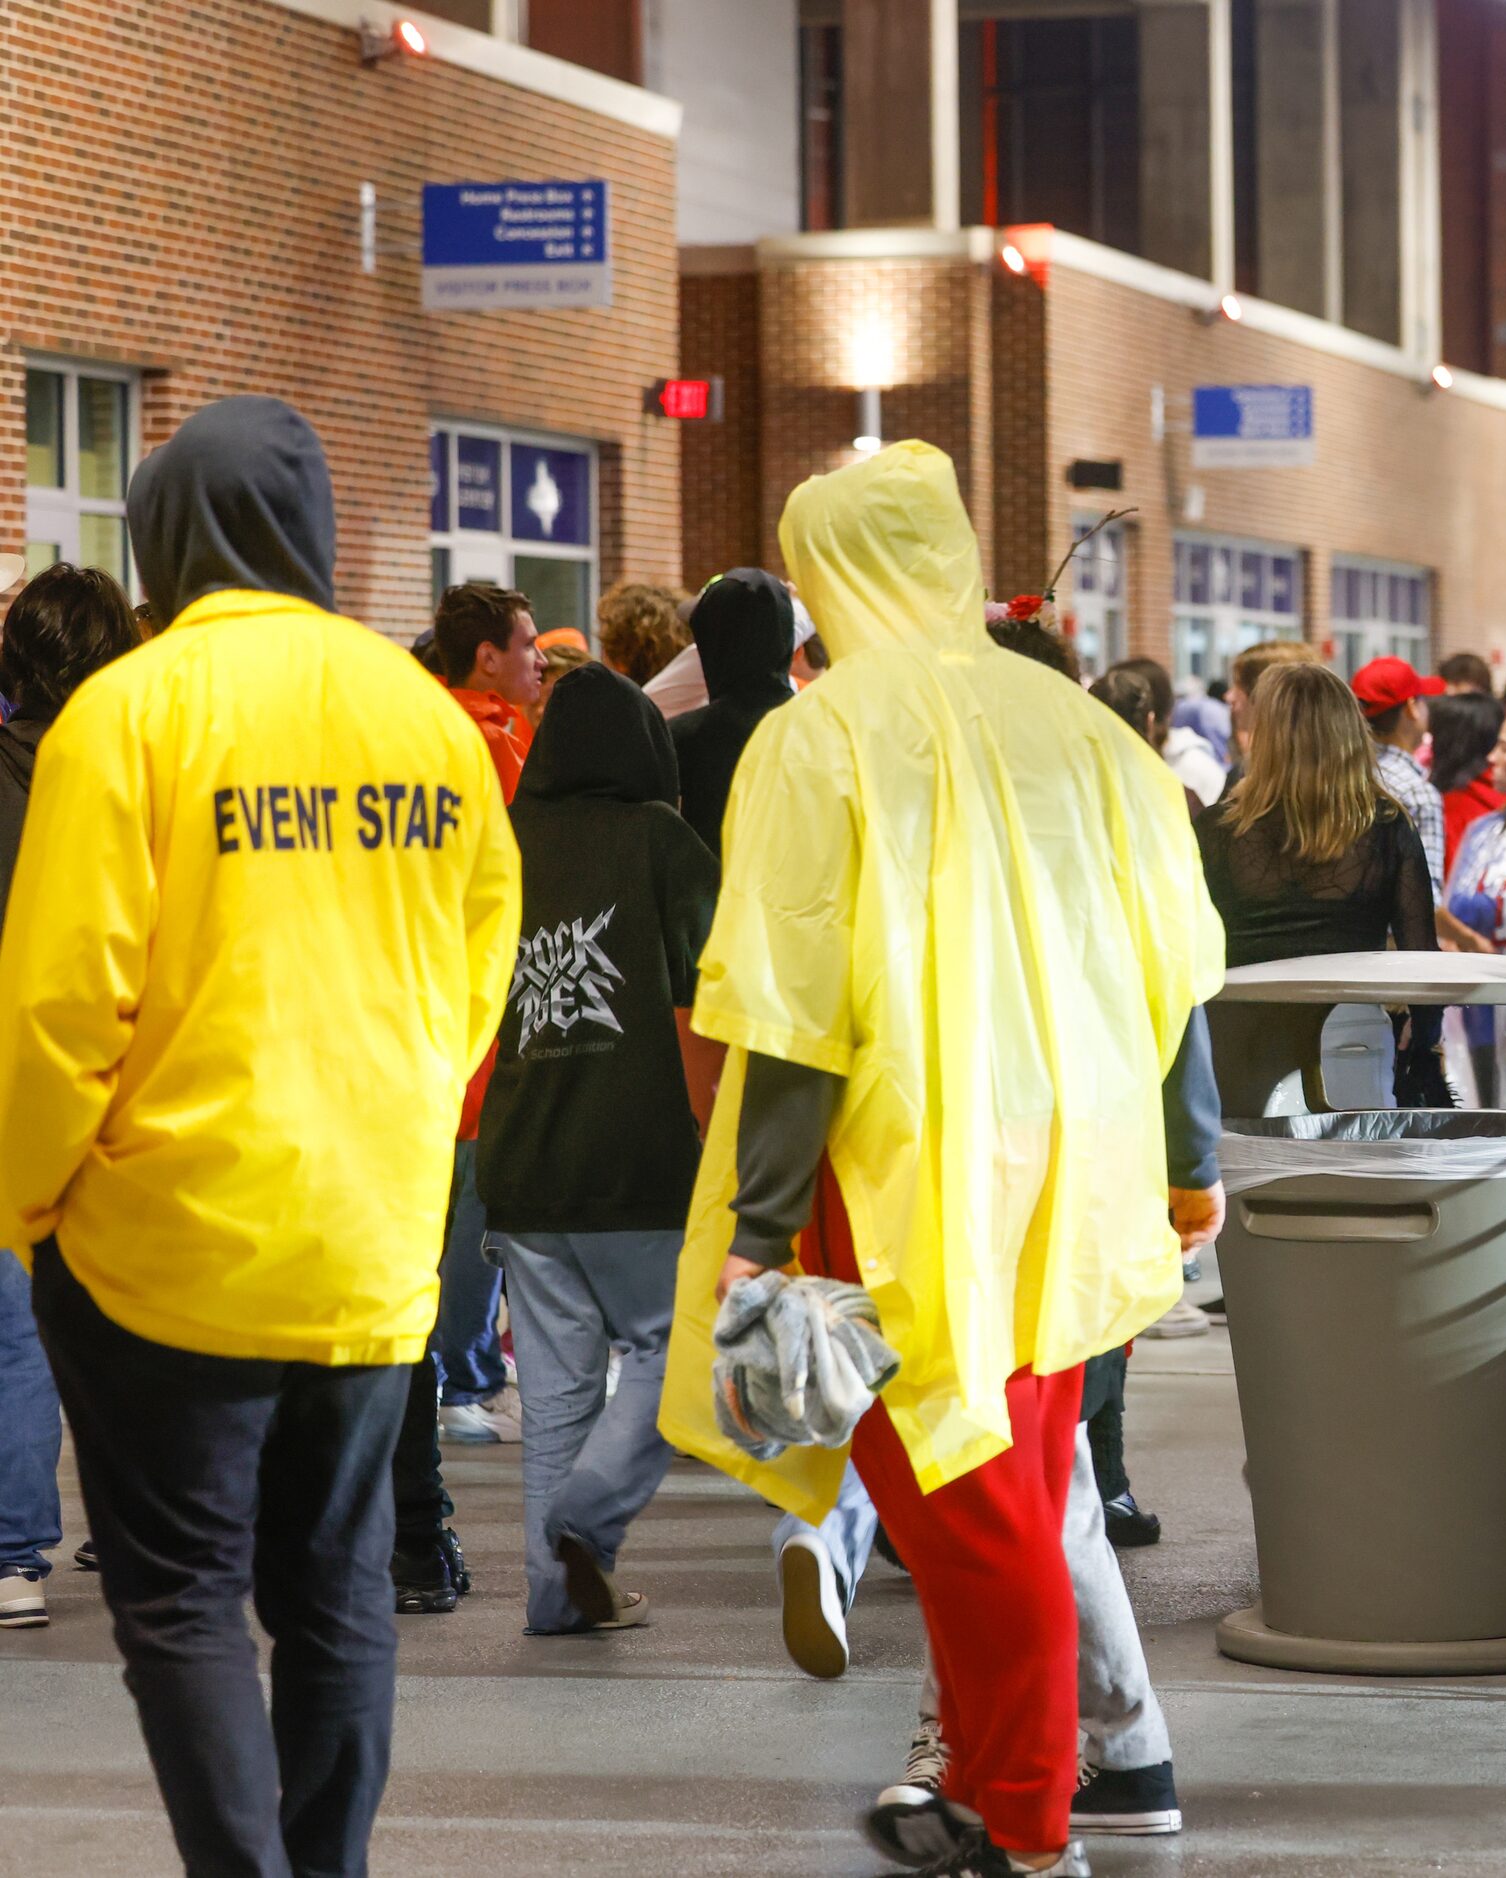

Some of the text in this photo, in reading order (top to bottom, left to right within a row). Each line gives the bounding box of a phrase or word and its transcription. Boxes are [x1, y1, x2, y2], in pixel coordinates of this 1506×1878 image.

[214, 783, 462, 854] EVENT STAF
[508, 903, 625, 1002] ROCK
